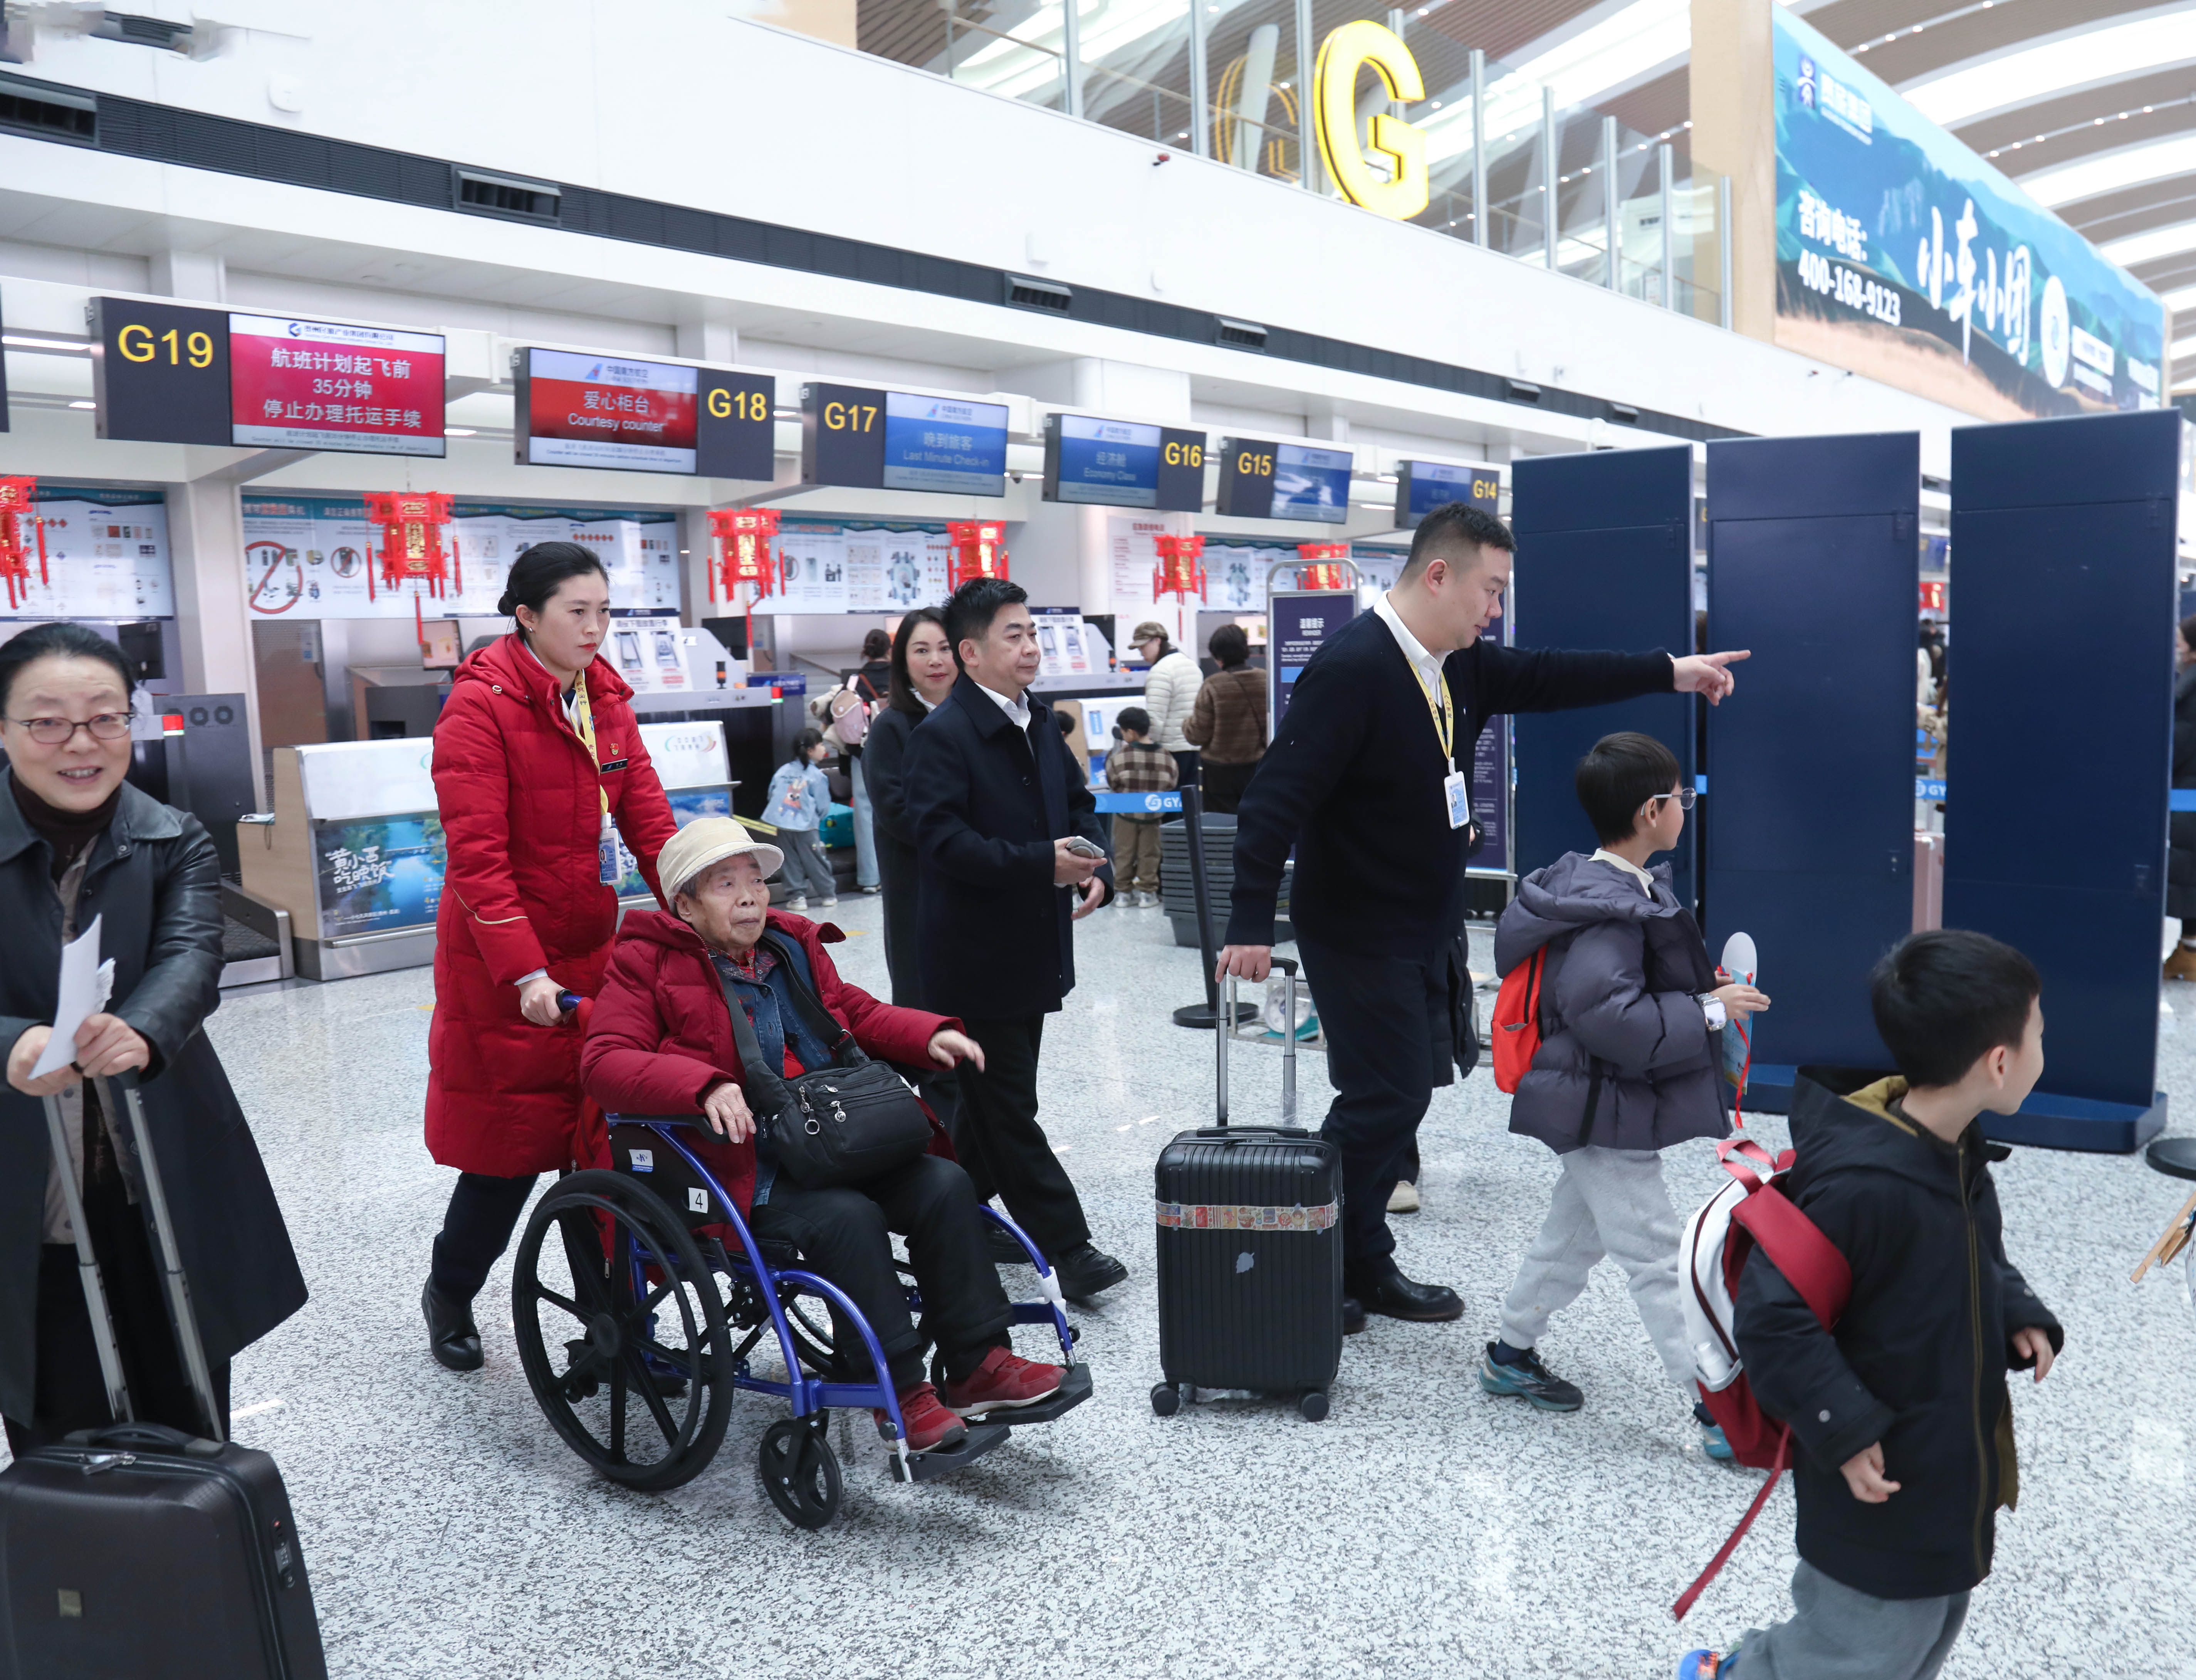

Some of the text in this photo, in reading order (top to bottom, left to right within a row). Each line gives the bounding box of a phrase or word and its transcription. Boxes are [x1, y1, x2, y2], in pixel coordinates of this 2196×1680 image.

[1314, 20, 1429, 220] G
[1798, 249, 1901, 326] 400-168-9123
[118, 324, 213, 368] G19
[271, 348, 411, 379] 航班计划起飞前
[312, 378, 373, 400] 35分钟
[263, 399, 421, 428] 停止办理托运手续
[583, 390, 650, 414] 爱心柜台
[708, 388, 767, 422] G18
[567, 412, 663, 432] Courtesy counter
[824, 402, 878, 432] G17
[923, 432, 973, 451] 晚到旅客
[903, 449, 922, 460] Last
[1165, 442, 1202, 467] G16
[1238, 452, 1272, 476] G15
[1473, 479, 1498, 500] G14
[325, 846, 379, 875] 黄小西
[333, 860, 396, 885] 吃晚饭
[695, 1193, 707, 1209] 4
